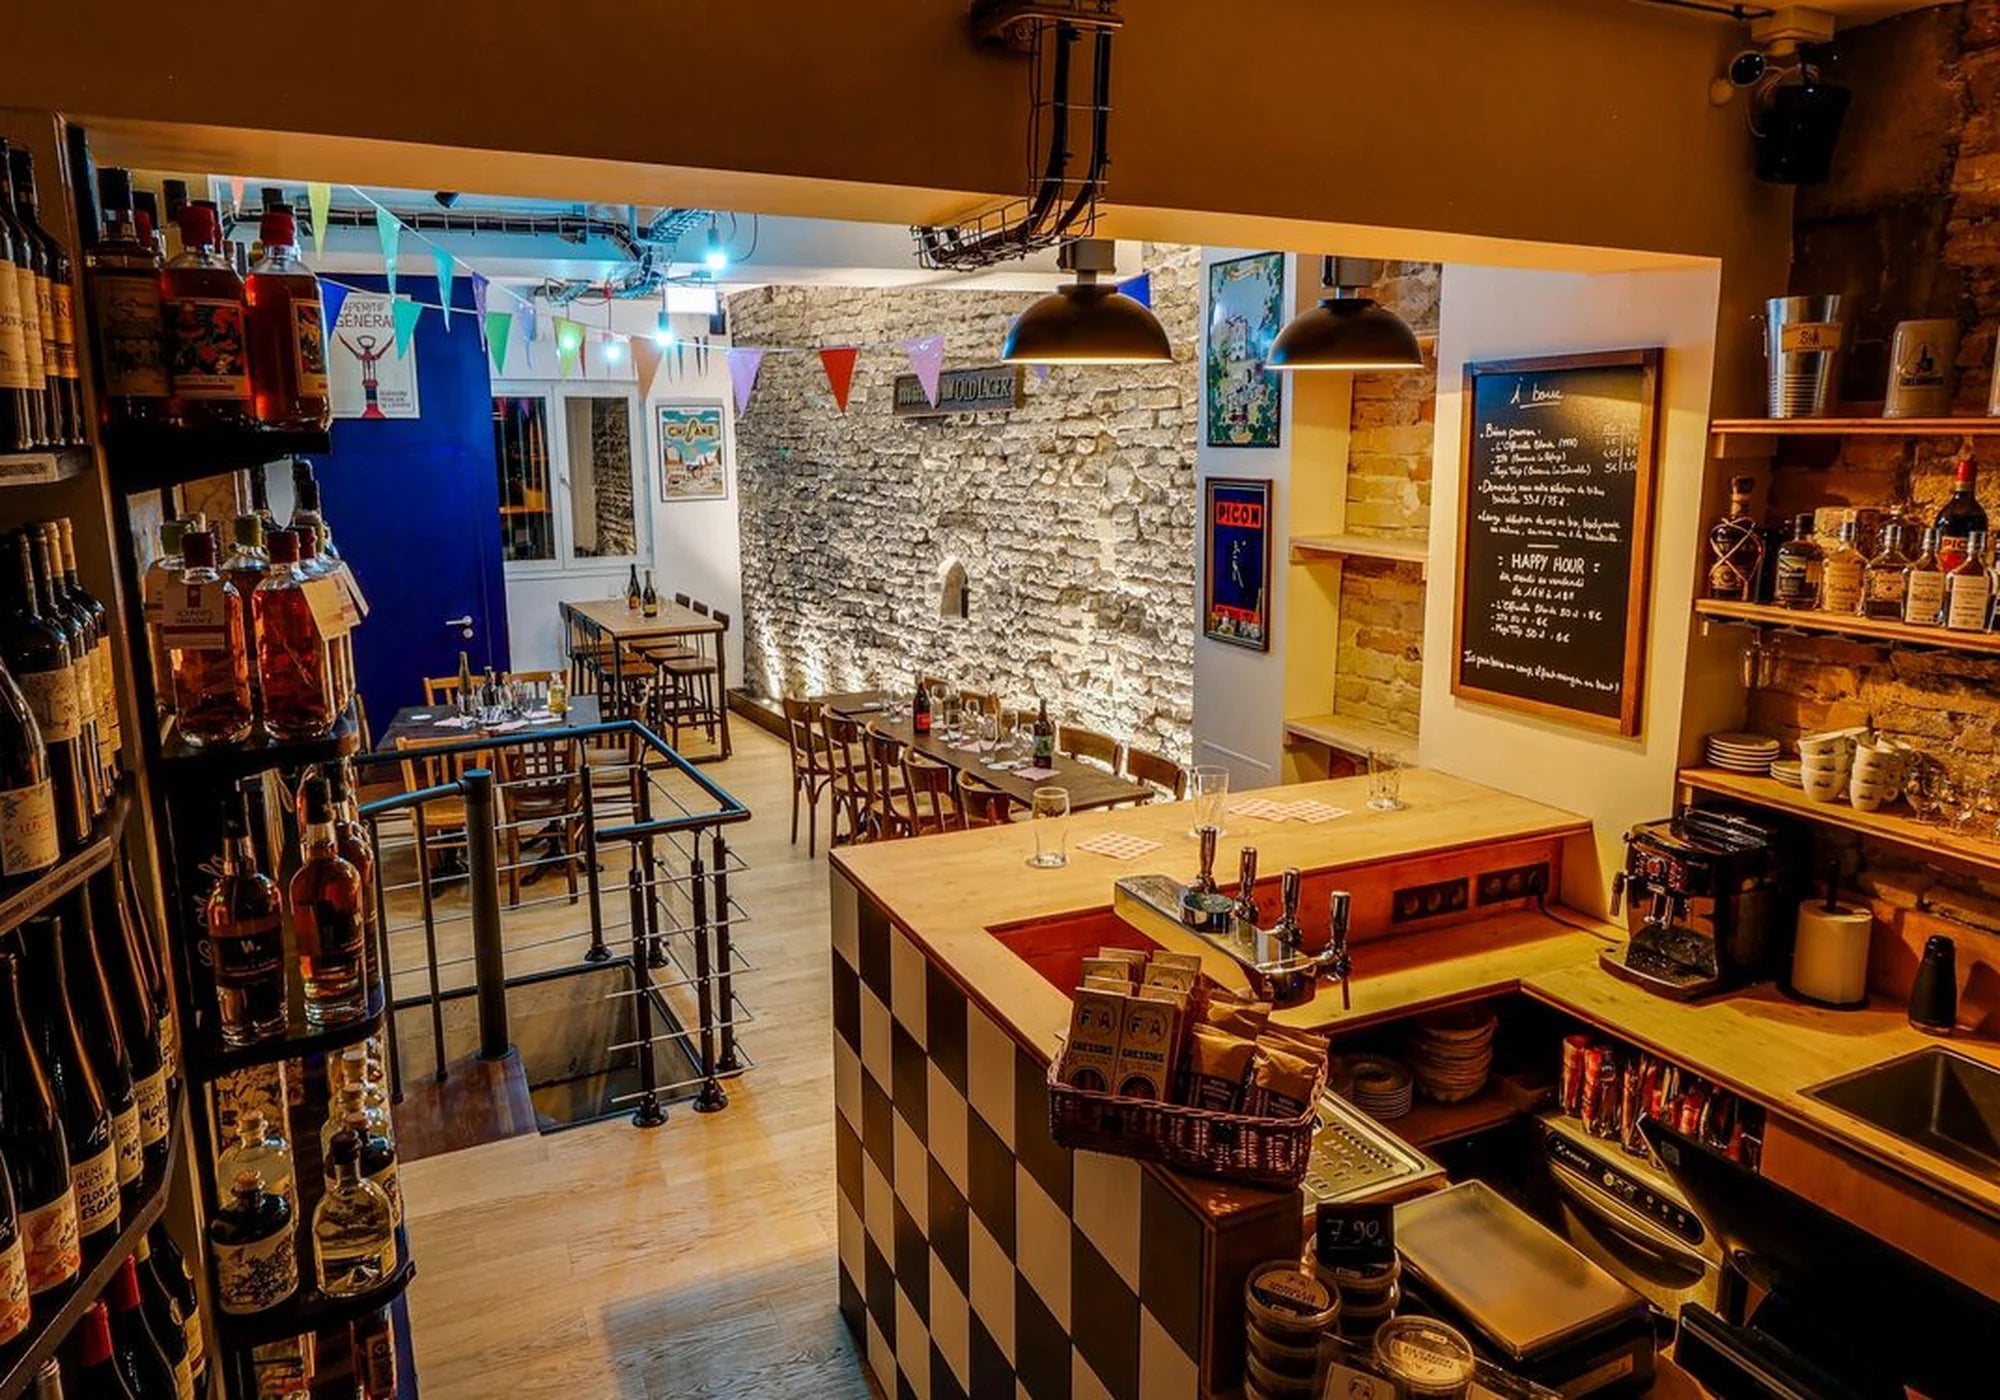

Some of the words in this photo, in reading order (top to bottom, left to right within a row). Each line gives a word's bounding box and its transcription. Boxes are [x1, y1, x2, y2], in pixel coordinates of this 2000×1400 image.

[1218, 503, 1260, 525] PICON
[1511, 554, 1549, 572] HAPPY
[1553, 556, 1585, 575] HOUR
[79, 1188, 106, 1207] CLOS
